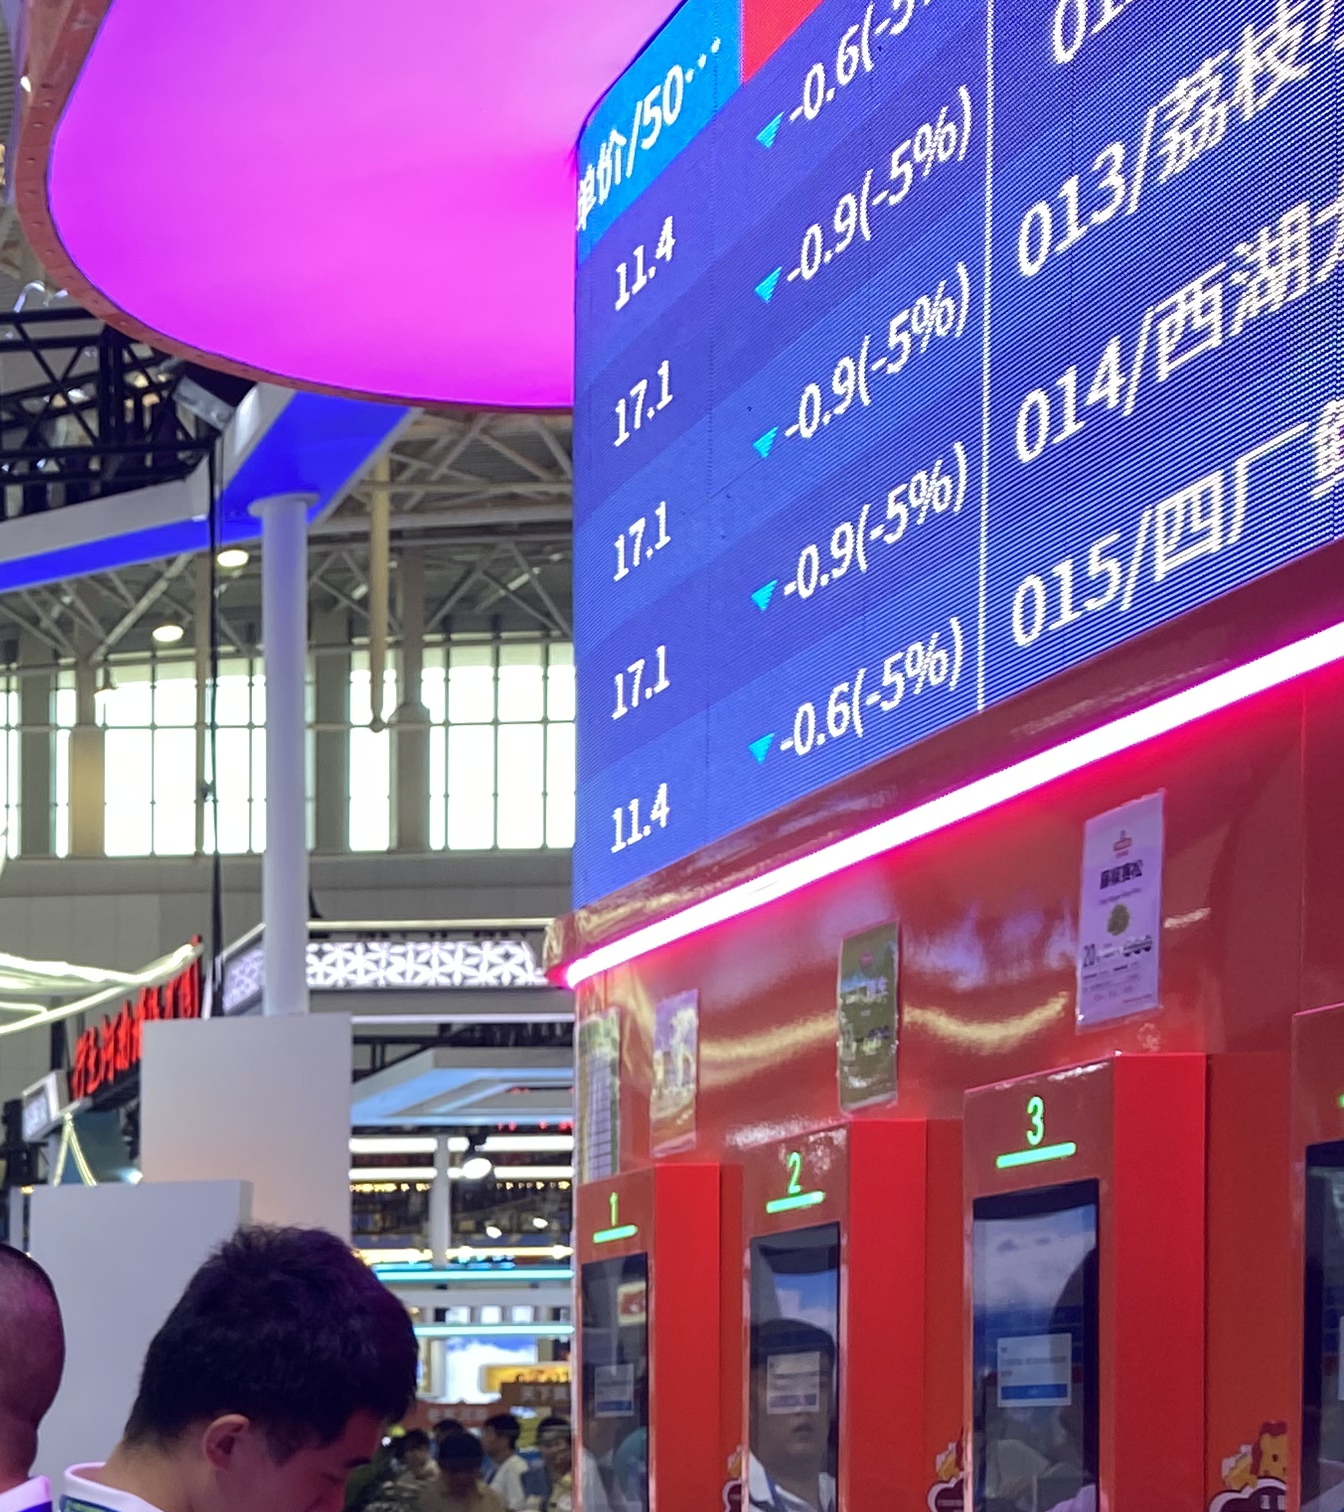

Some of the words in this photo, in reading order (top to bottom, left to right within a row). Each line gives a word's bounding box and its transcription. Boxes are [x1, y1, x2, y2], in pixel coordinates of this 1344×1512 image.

[1018, 0, 1344, 278] 013/荔枝
[786, 84, 973, 284] -0.9(-5%)
[613, 215, 676, 310] 11.4
[784, 262, 971, 443] -0.9(-5%)
[613, 360, 674, 447] 17.1
[612, 501, 672, 583] 17.1
[783, 442, 968, 601] -0.9(-5%)
[611, 646, 671, 721] 17.1
[779, 617, 964, 758] -0.6(-5%)
[610, 783, 670, 855] 11.4
[1026, 1096, 1045, 1146] 3
[608, 1192, 618, 1227] 1
[787, 1152, 802, 1193] 2
